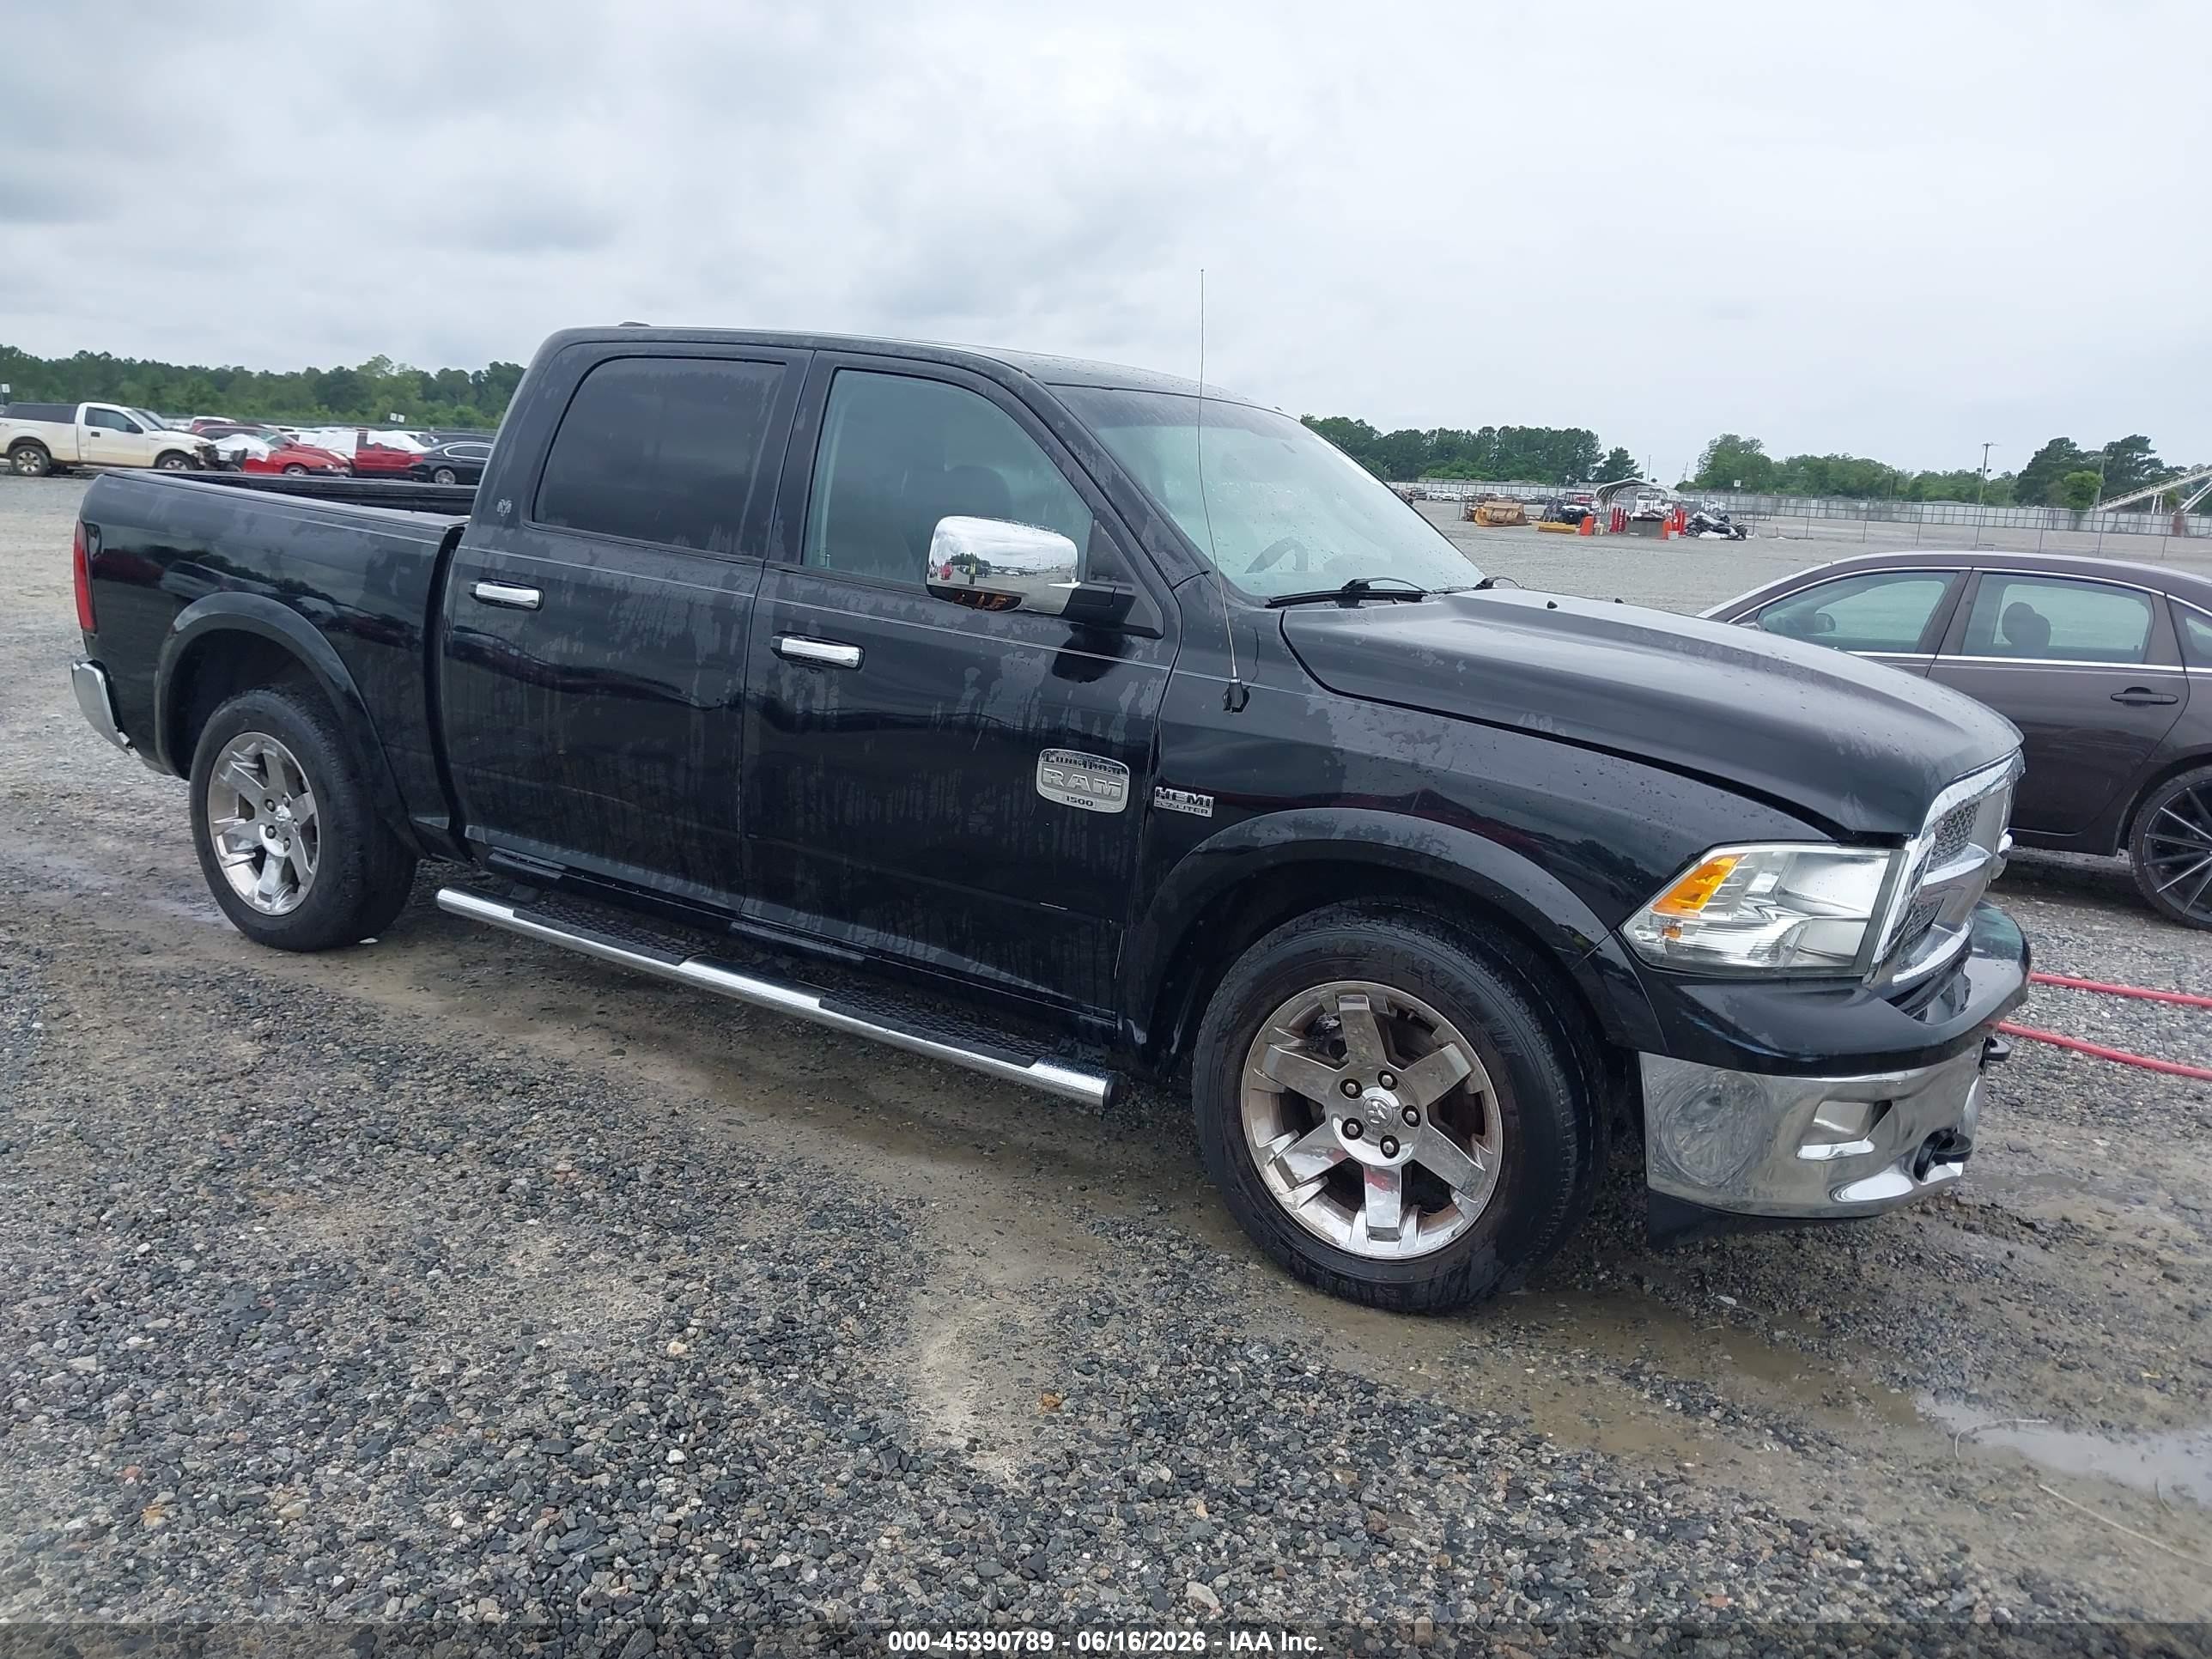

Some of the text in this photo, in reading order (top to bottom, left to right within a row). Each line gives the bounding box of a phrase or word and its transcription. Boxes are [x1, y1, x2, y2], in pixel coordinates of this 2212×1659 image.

[1042, 768, 1123, 799] RAM
[1066, 795, 1095, 808] 1500
[1155, 787, 1212, 808] HEMI
[1175, 803, 1209, 815] LITER
